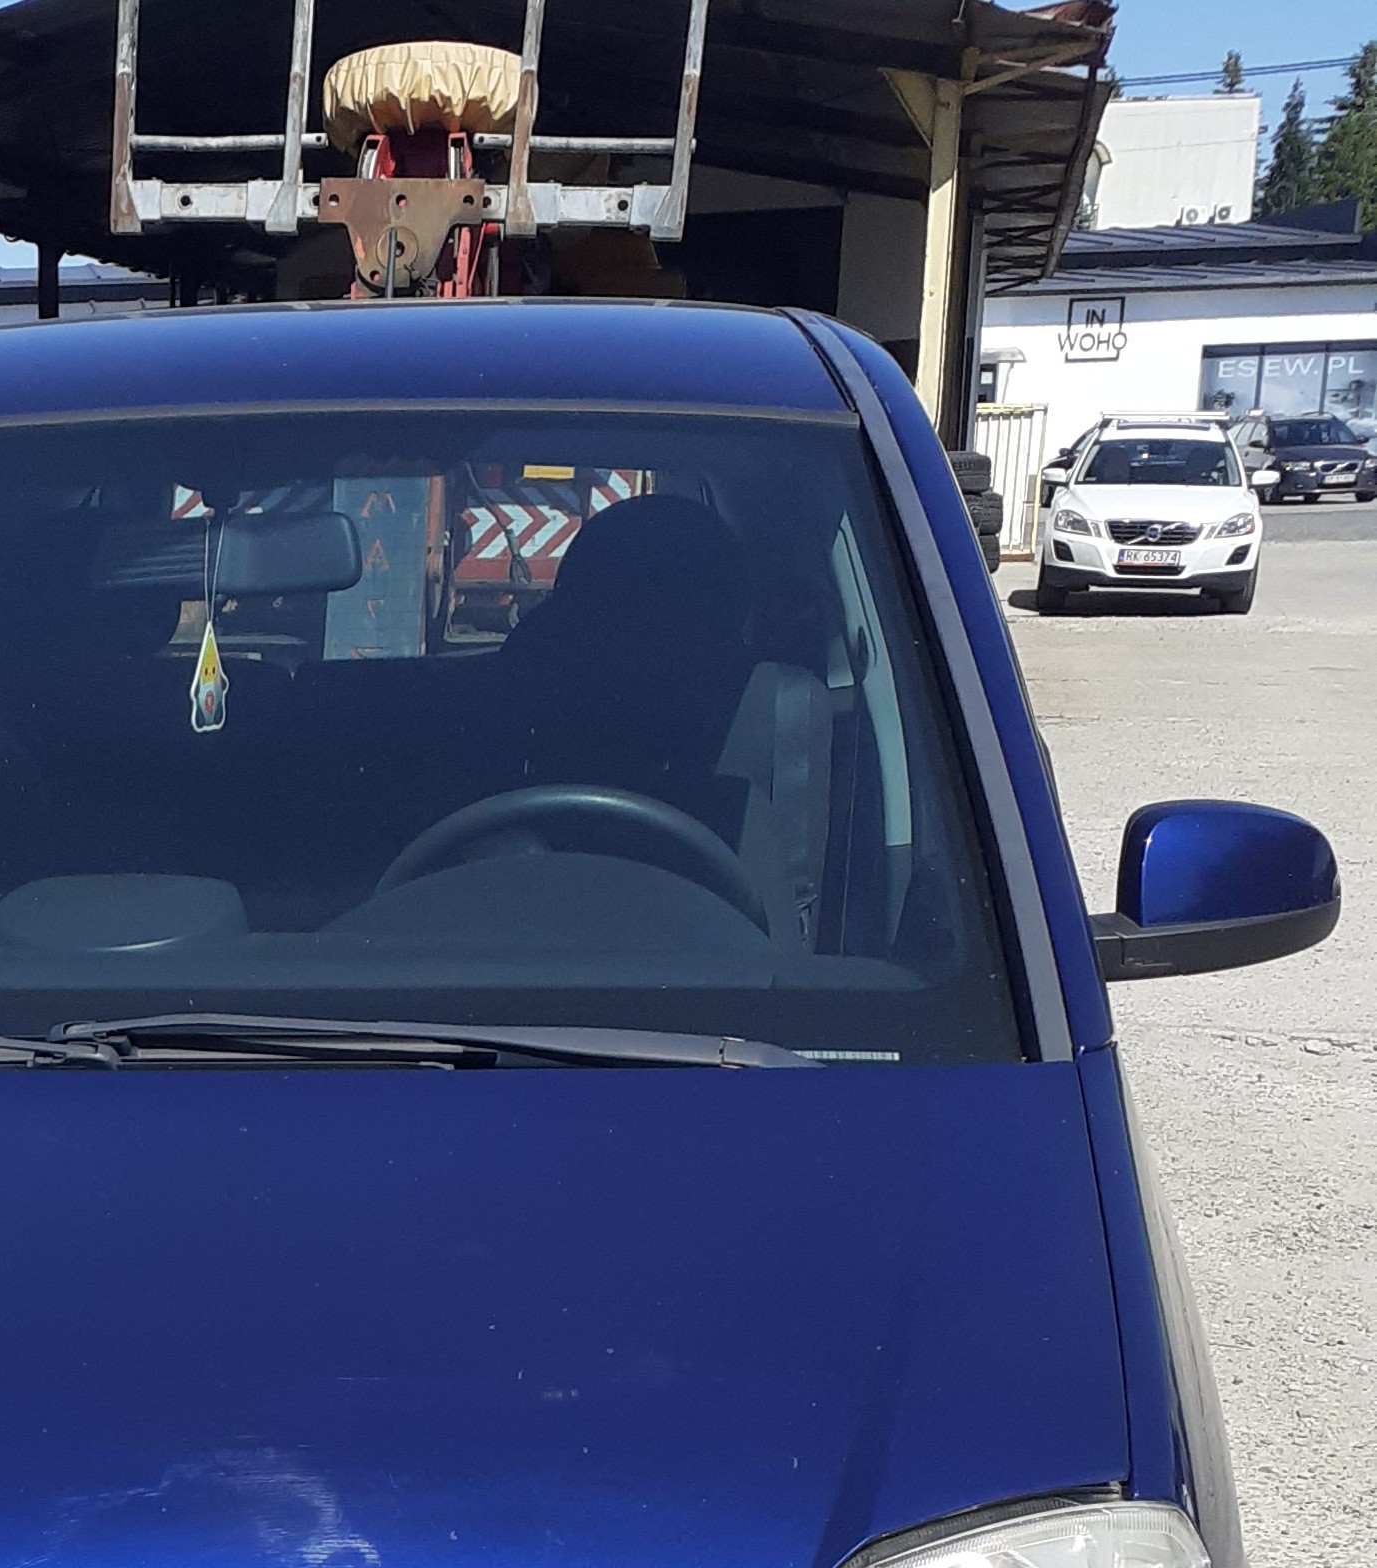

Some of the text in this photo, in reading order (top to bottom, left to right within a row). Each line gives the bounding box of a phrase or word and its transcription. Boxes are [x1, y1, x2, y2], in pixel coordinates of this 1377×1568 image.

[1085, 307, 1106, 328] IN
[1057, 331, 1127, 353] WOHO
[1125, 551, 1178, 563] RK 65374
